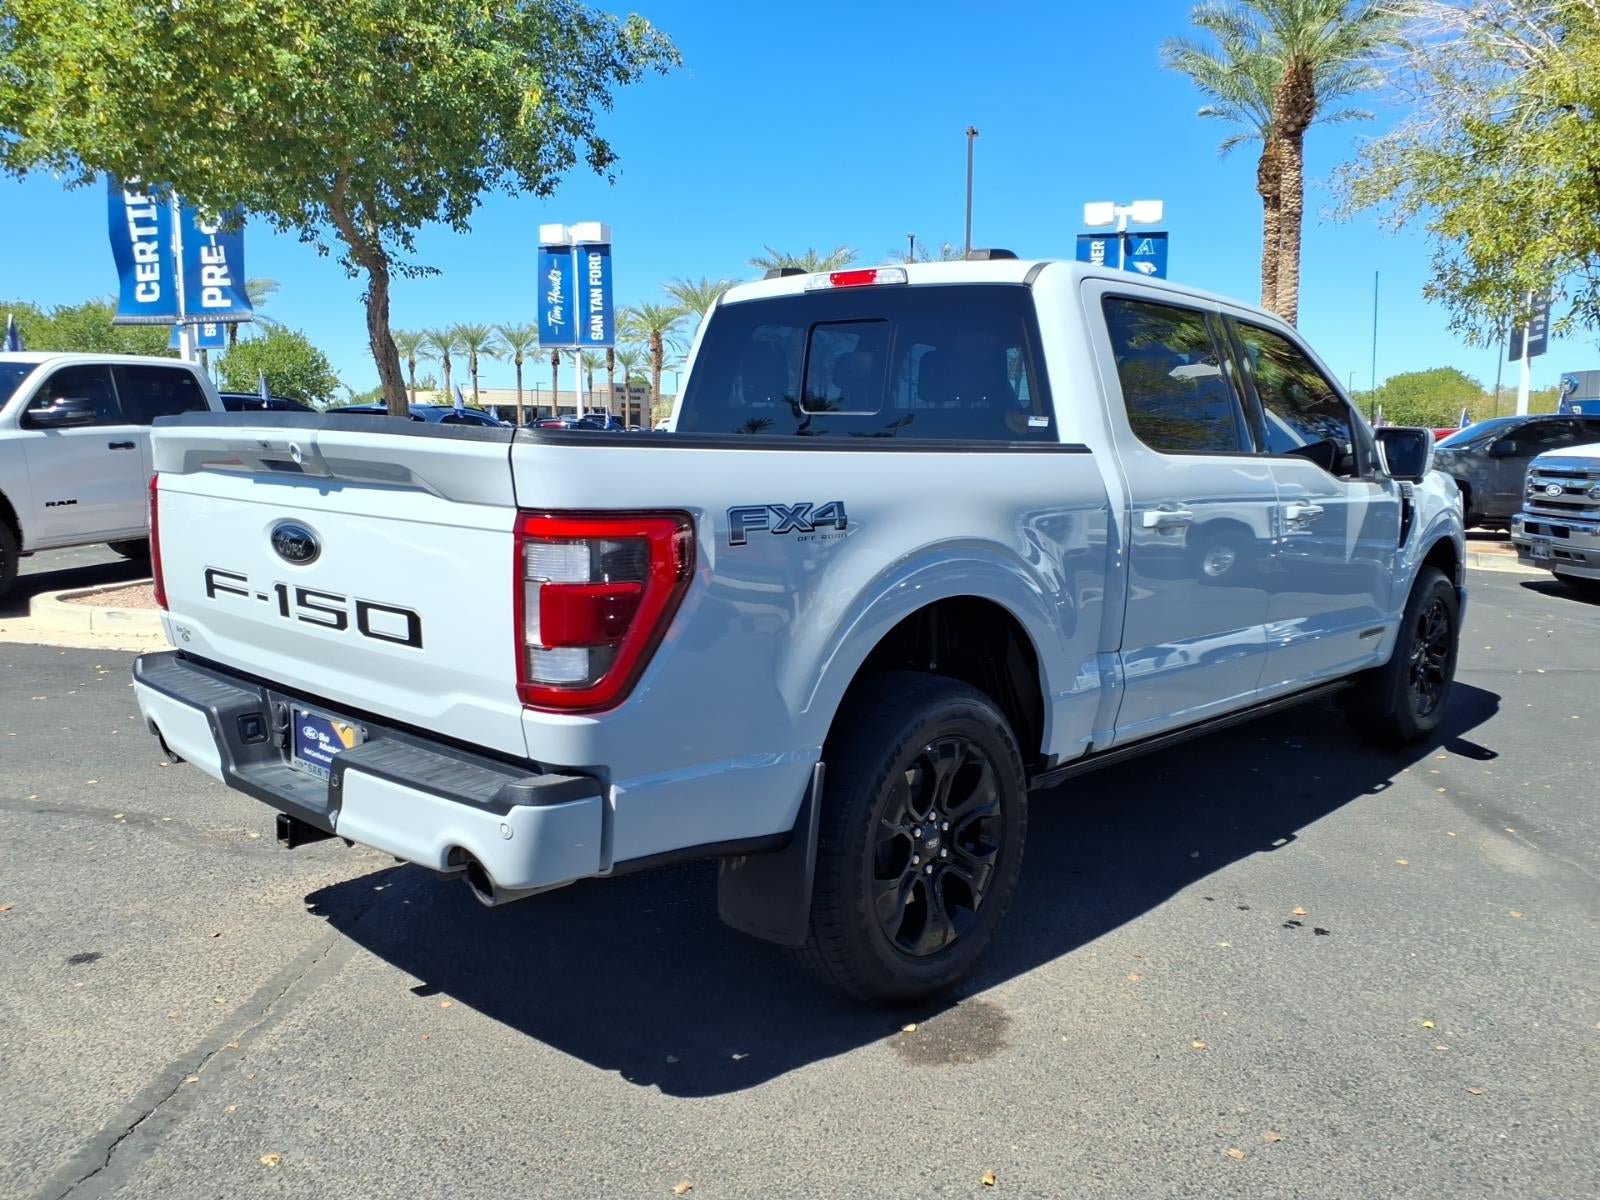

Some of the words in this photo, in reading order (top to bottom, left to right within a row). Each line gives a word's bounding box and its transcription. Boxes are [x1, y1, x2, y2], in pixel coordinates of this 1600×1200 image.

[588, 252, 602, 286] FORD
[590, 287, 603, 313] TAN
[547, 305, 566, 327] Tim
[591, 314, 604, 341] SAN
[45, 499, 78, 507] RAM
[726, 501, 848, 547] FX4
[797, 535, 816, 543] OFF
[204, 565, 424, 650] F-150
